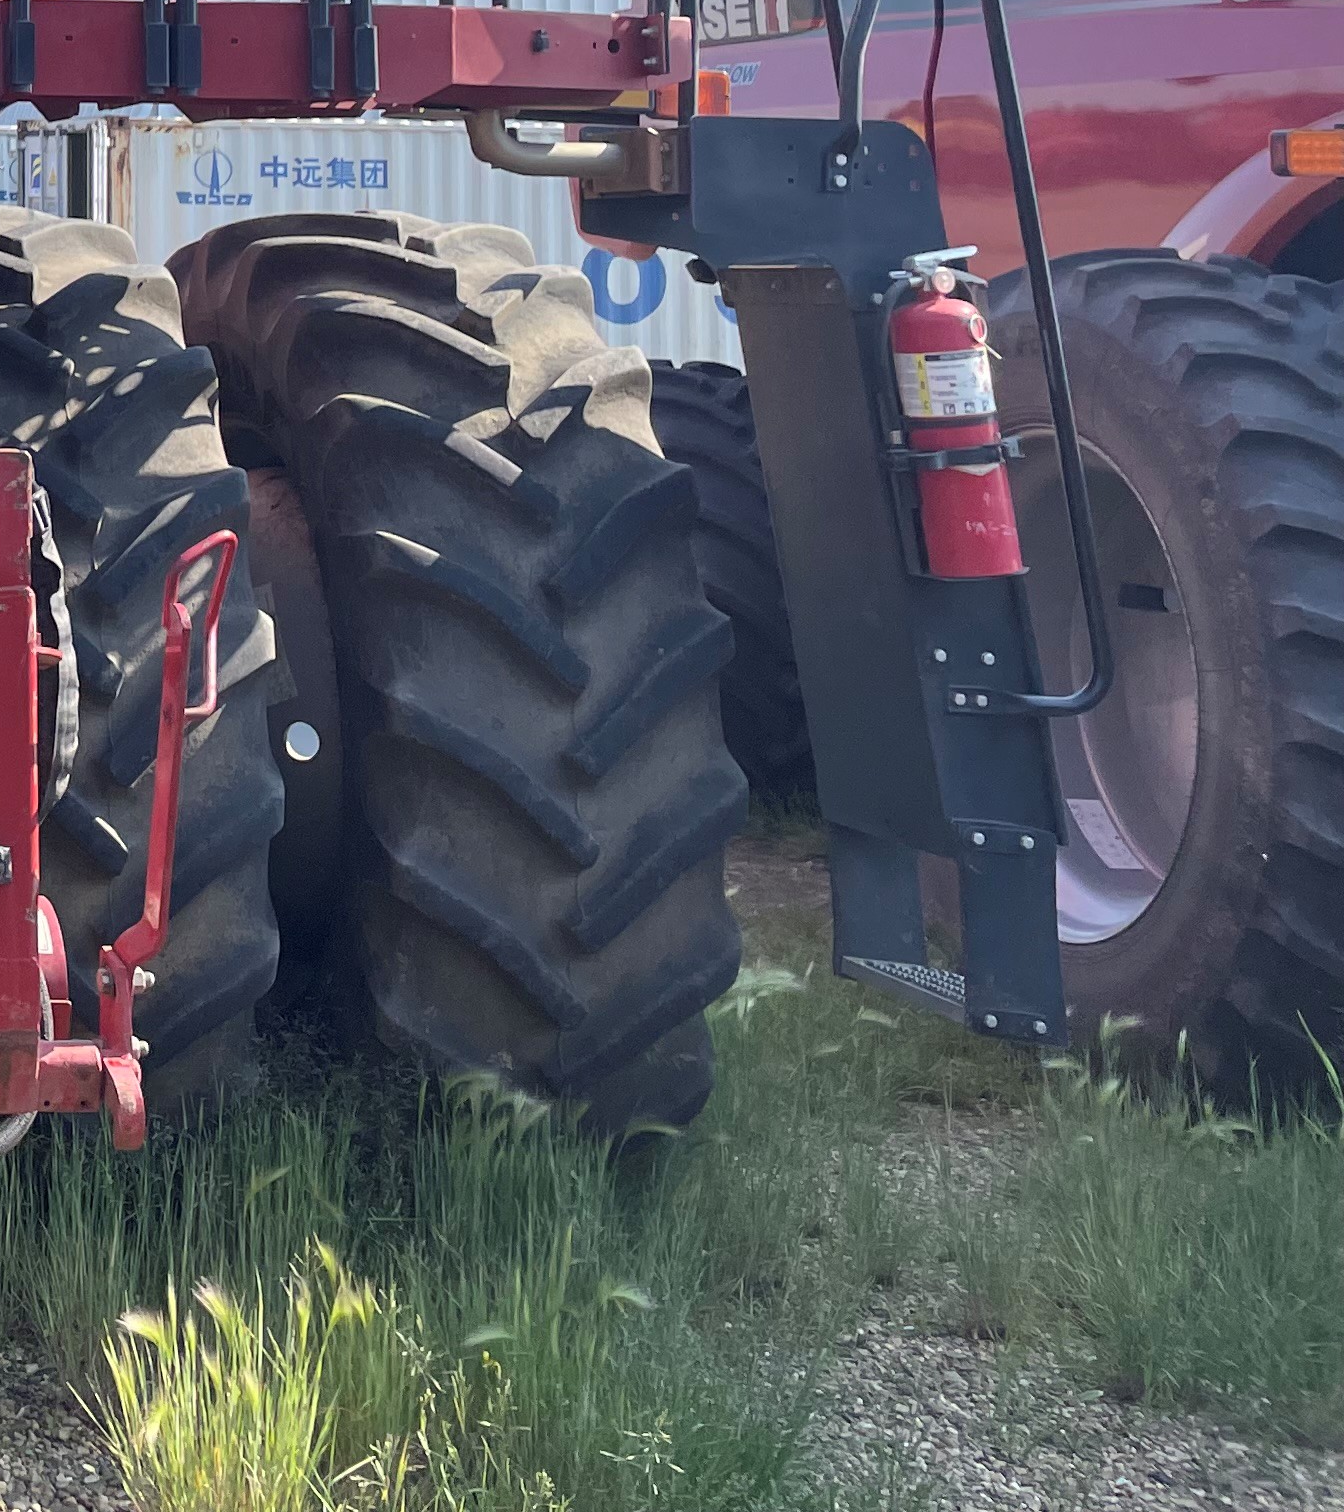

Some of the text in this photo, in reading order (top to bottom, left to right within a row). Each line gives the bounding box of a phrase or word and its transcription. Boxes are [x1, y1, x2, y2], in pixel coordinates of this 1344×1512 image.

[260, 155, 389, 189] 中远集团
[176, 191, 253, 205] COSCO
